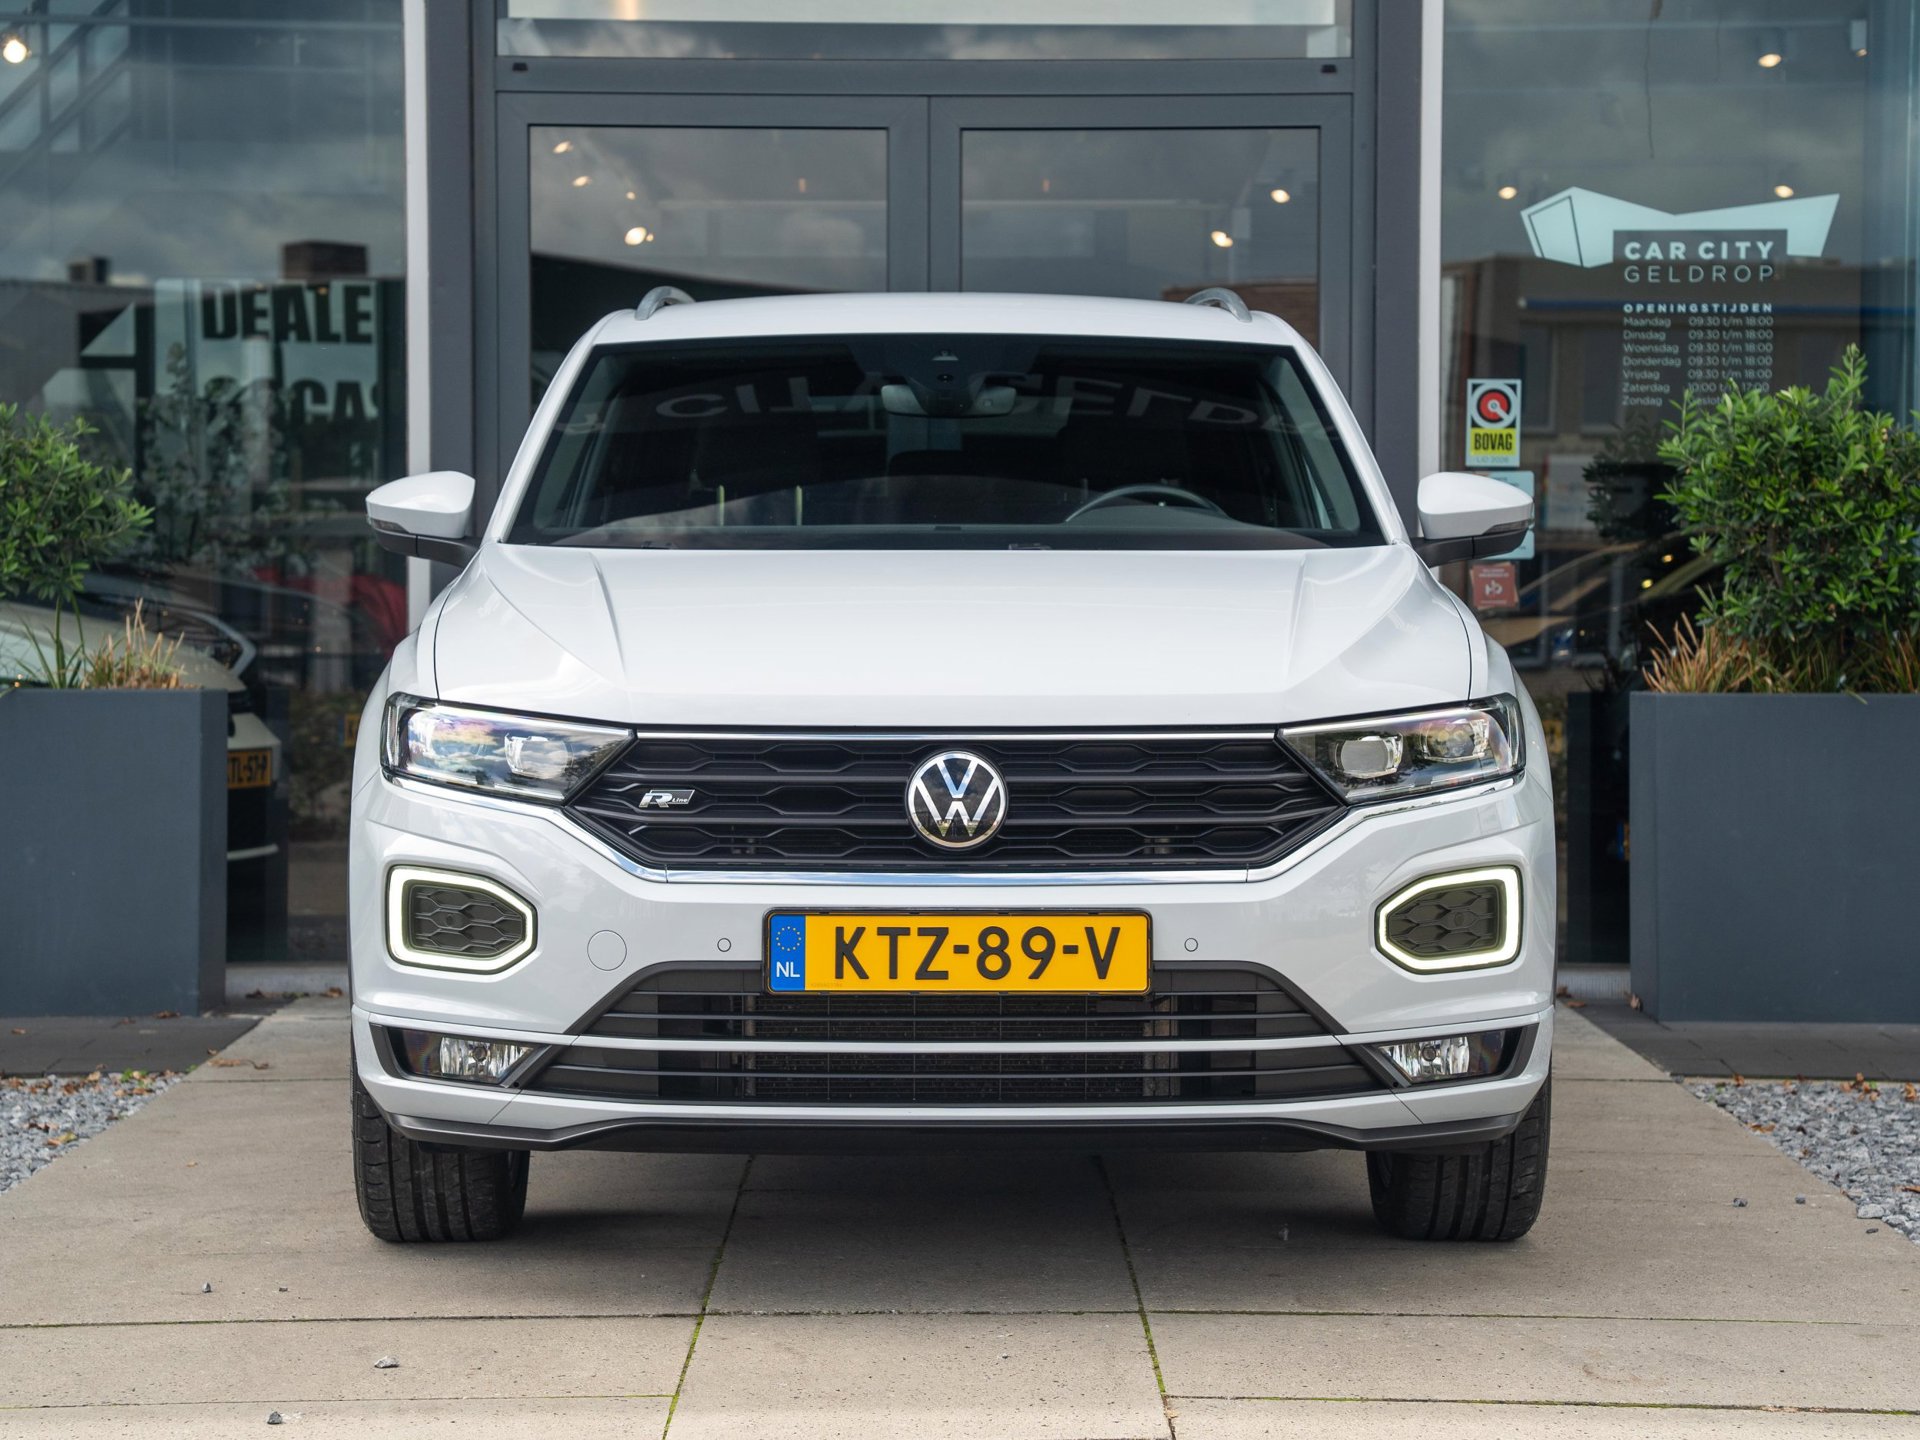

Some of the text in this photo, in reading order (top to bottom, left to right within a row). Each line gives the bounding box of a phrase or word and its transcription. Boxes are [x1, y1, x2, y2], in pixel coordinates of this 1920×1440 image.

[1624, 241, 1774, 260] CAR CITY
[1624, 265, 1774, 283] GELDROP
[1623, 303, 1773, 313] OPENINGSTIJDEN
[1623, 316, 1672, 328] Maandag
[1623, 329, 1667, 341] Dinsdag
[1622, 342, 1680, 355] Woensdag
[1622, 355, 1682, 368] Donderdag
[1622, 369, 1660, 381] Vrijdag
[1622, 382, 1671, 394] Zaterdag
[1622, 395, 1663, 407] Zondag
[1474, 433, 1513, 450] BOVAG
[639, 792, 673, 808] R
[834, 926, 1121, 980] KTZ-89-V
[776, 961, 801, 977] NL
